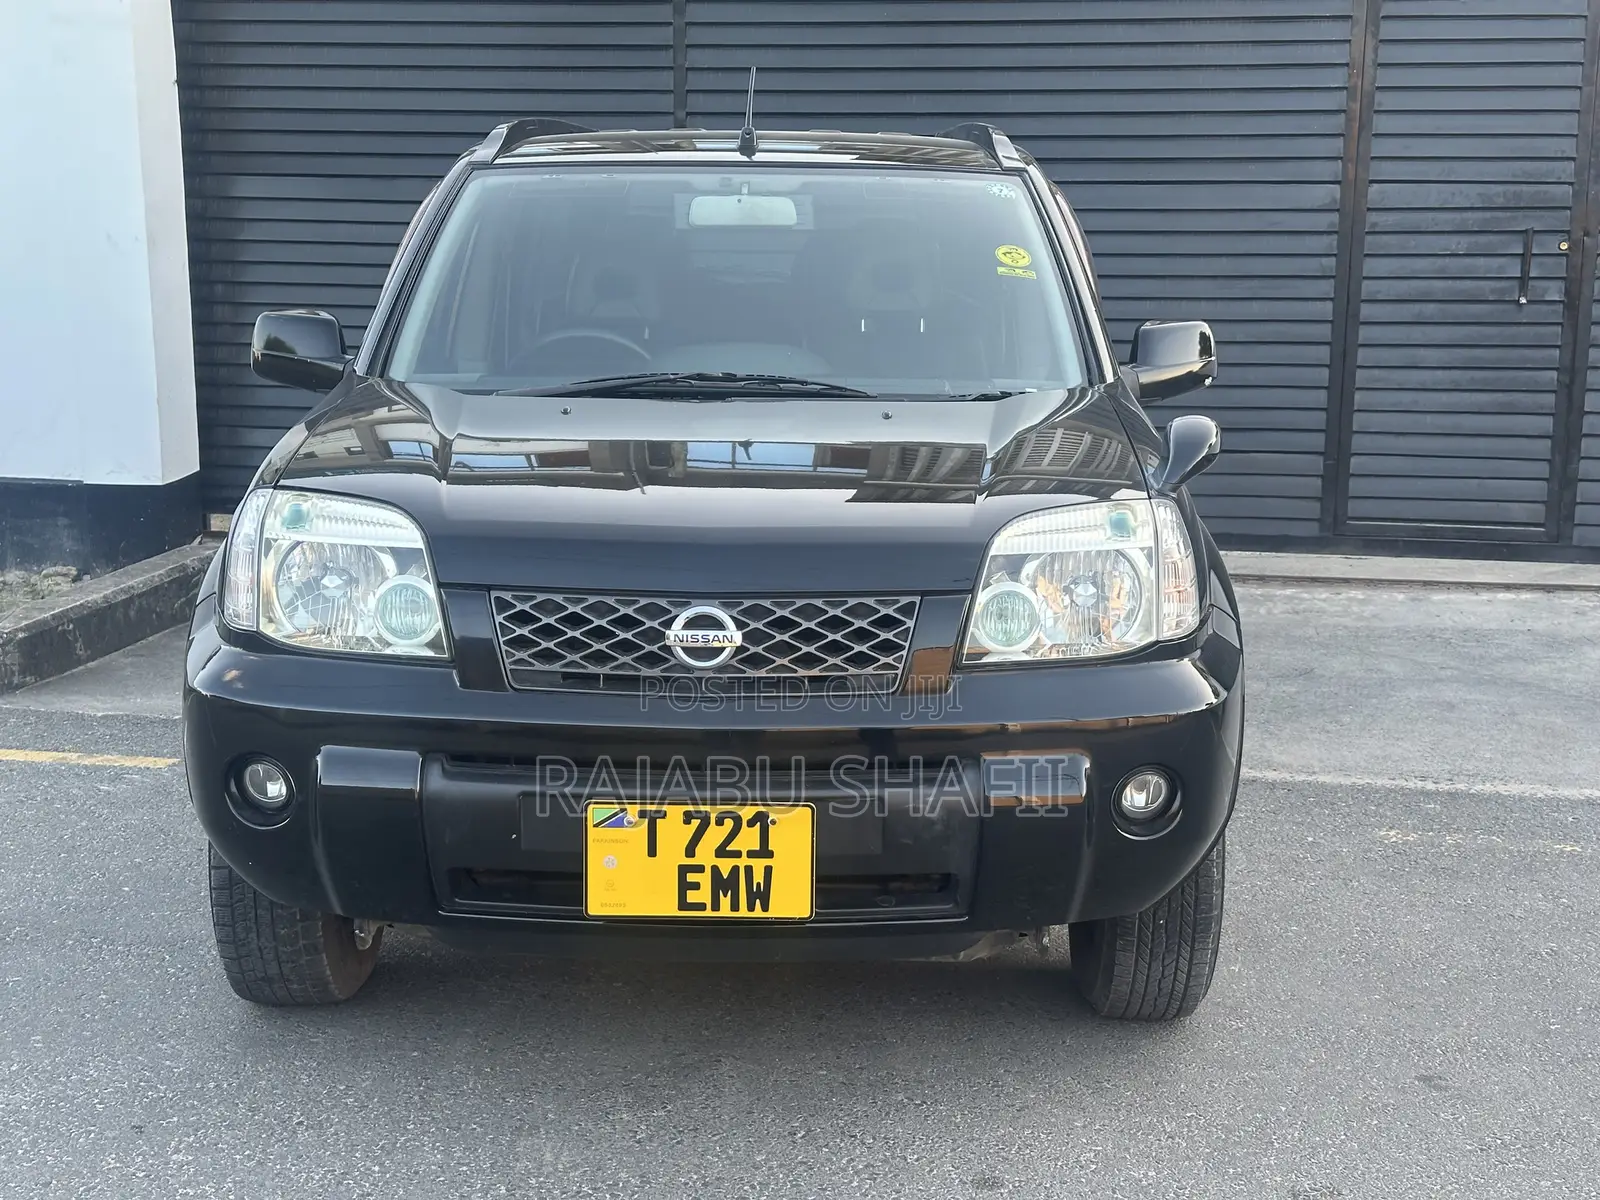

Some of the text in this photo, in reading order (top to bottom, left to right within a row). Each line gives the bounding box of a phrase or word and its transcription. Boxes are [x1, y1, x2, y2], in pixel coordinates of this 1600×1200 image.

[673, 633, 734, 644] NISSAN
[638, 809, 775, 859] T 721
[677, 863, 774, 913] EMW
